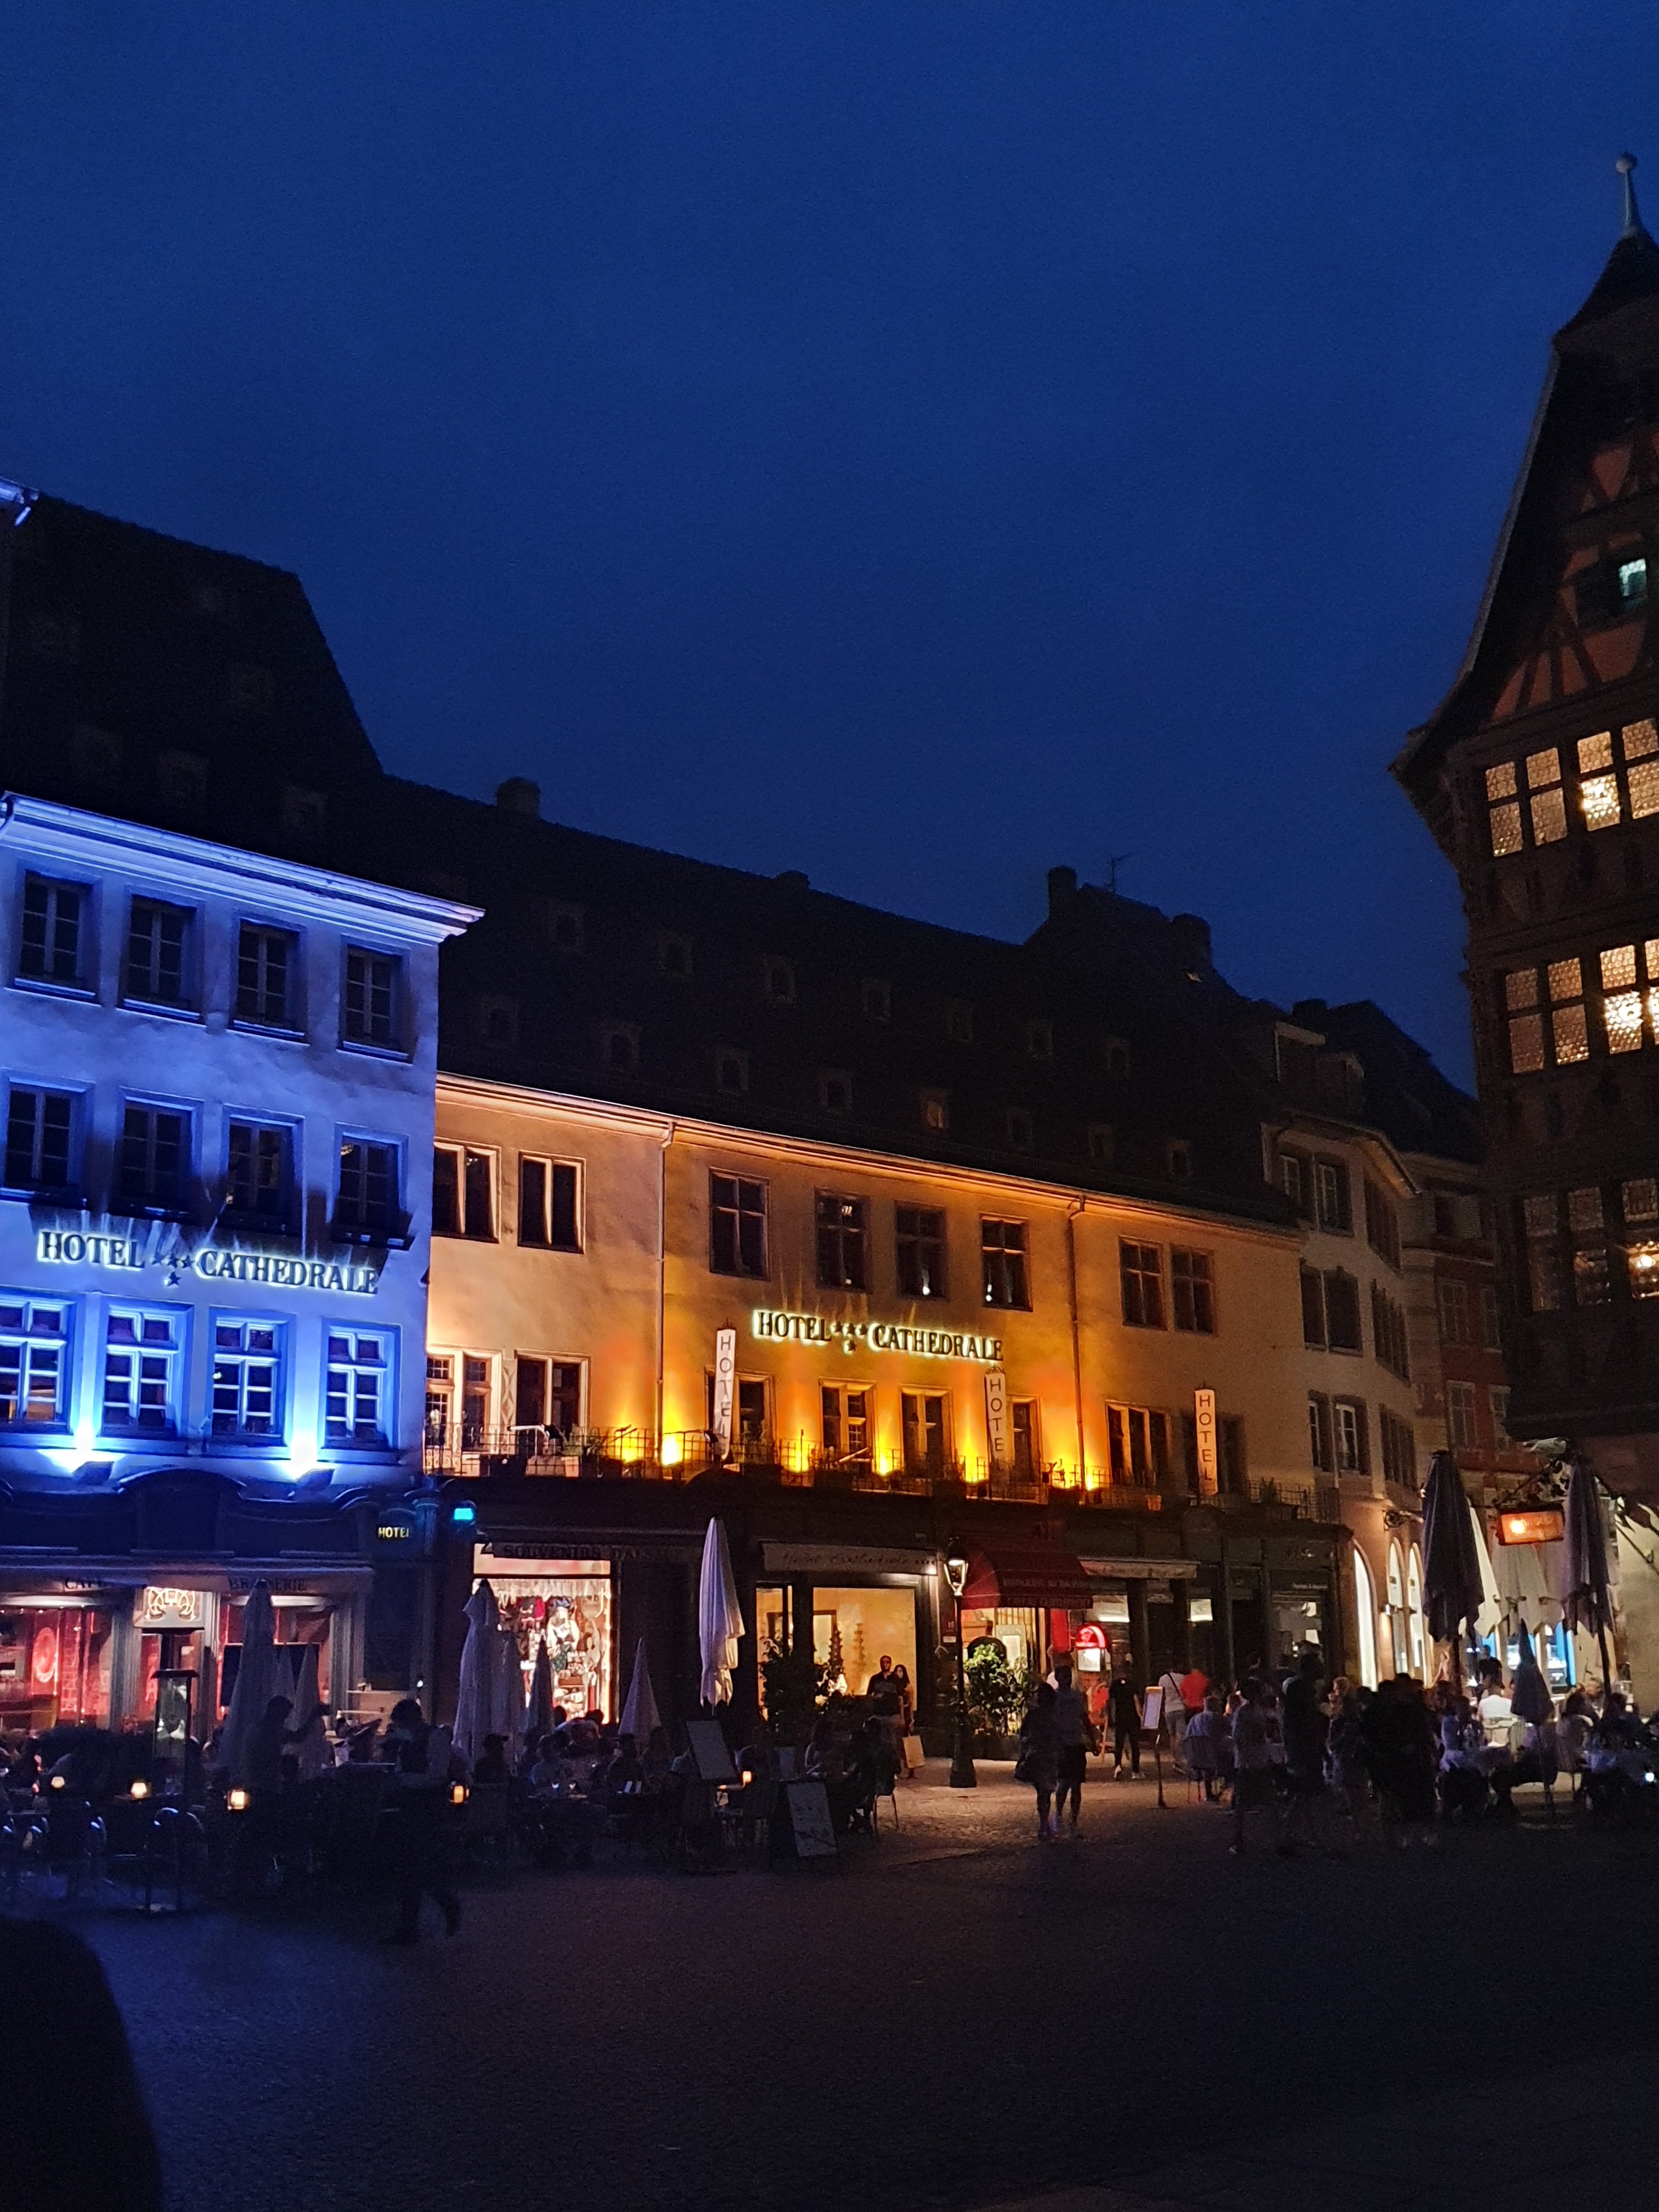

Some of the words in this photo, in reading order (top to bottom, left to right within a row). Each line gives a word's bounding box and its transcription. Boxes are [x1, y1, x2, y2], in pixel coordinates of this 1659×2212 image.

[40, 1231, 146, 1269] HOTEL
[196, 1250, 378, 1295] CATHEDRALE
[759, 1311, 832, 1342] HOTEL
[873, 1324, 1003, 1361] CATHEDRALE
[989, 1378, 1005, 1471] HOTEL
[1199, 1394, 1213, 1481] HOTEL
